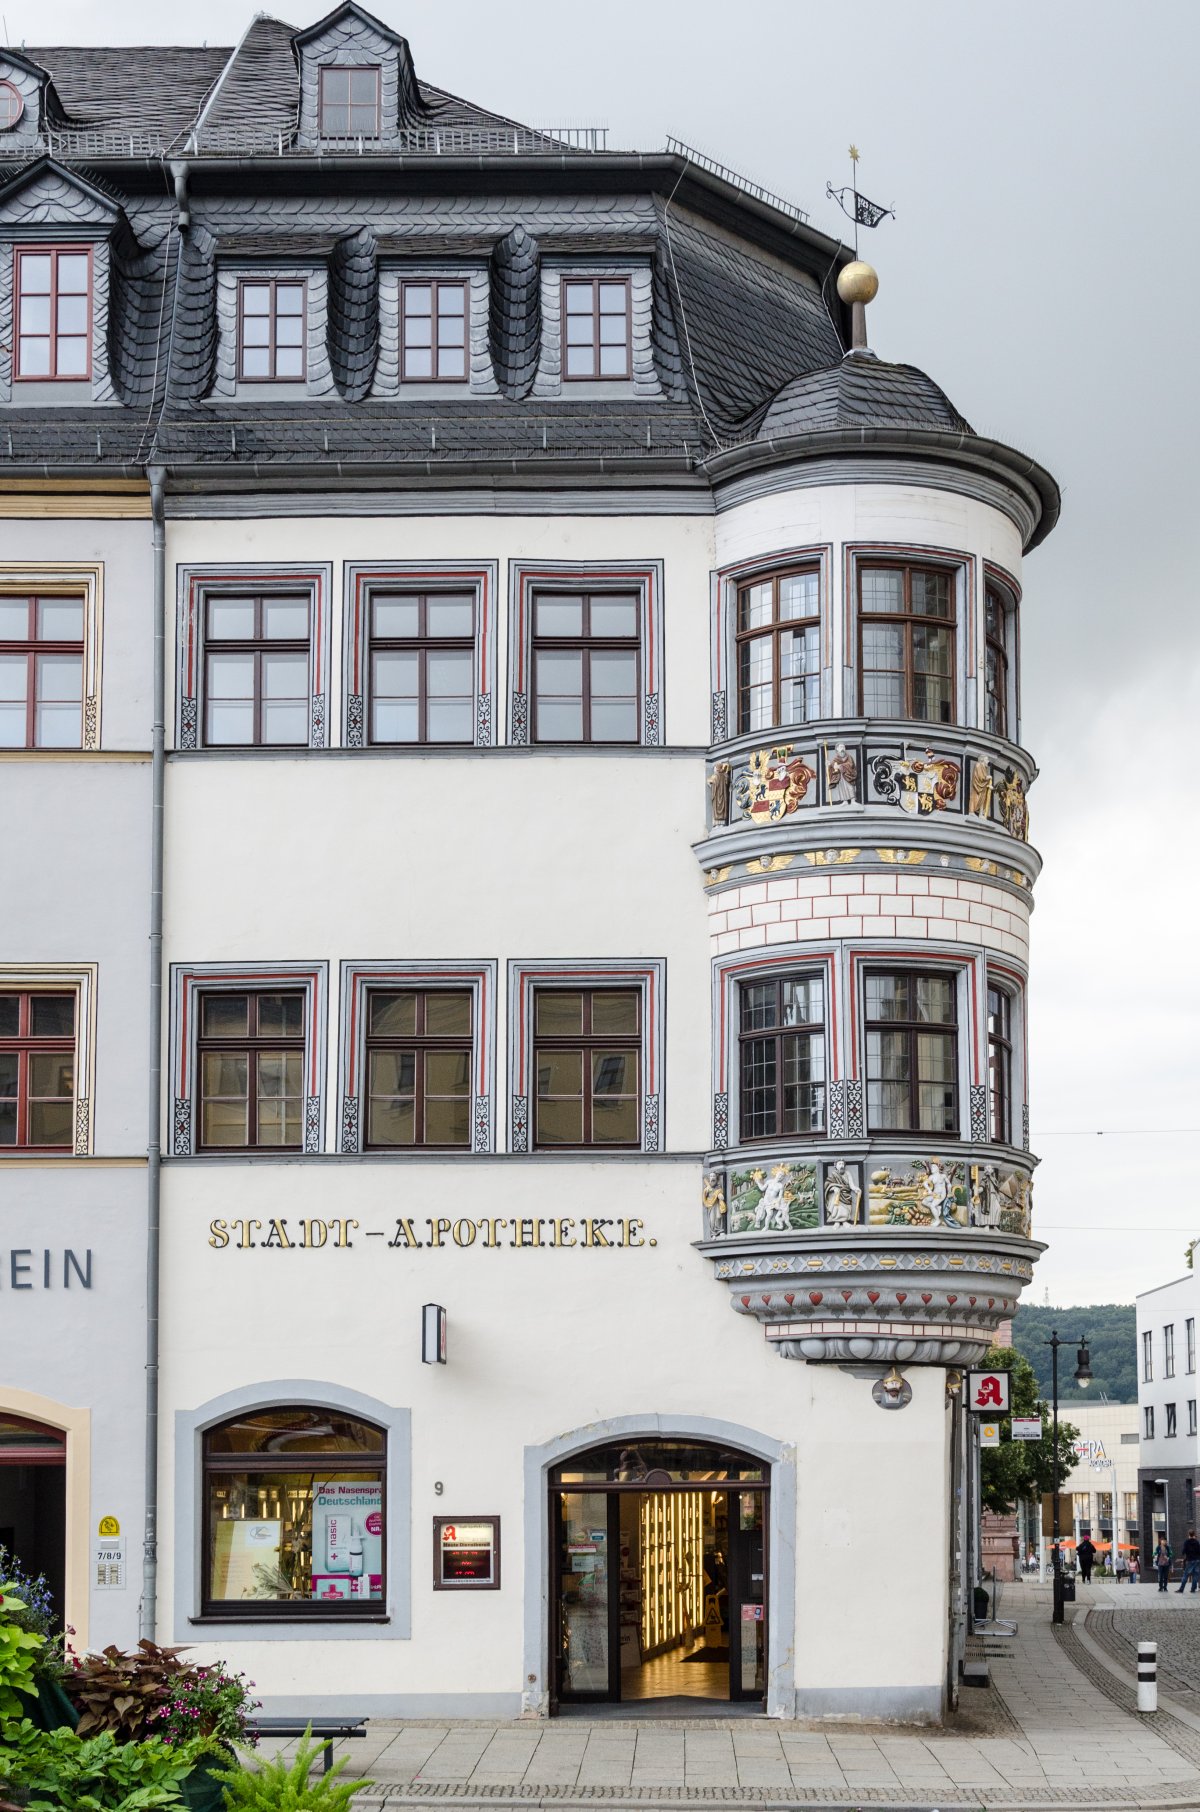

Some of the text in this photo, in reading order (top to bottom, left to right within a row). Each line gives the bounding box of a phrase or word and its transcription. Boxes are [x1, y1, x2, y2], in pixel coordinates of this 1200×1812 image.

[318, 1486, 335, 1494] Das
[434, 1481, 444, 1496] 9
[328, 1519, 337, 1546] nasic
[97, 1552, 122, 1560] 7/8/9
